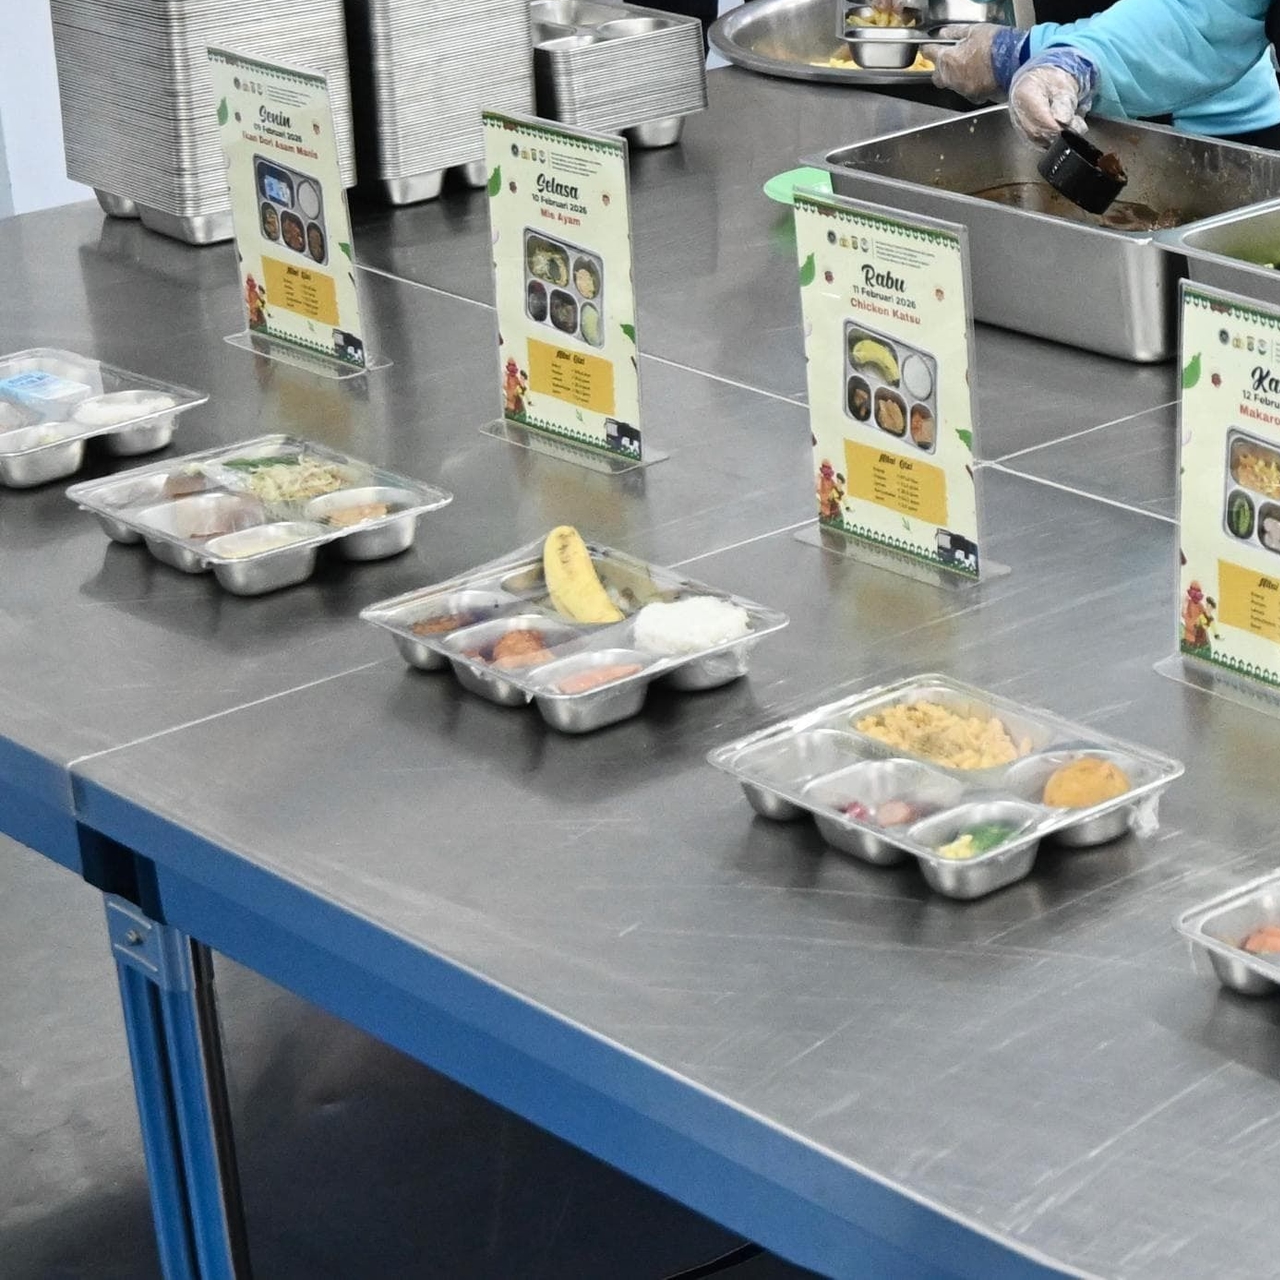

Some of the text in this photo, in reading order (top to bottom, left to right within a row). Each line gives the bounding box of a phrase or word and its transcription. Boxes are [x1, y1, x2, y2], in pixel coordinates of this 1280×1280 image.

[259, 105, 291, 128] Senin
[536, 173, 579, 200] Selasa
[532, 193, 587, 214] 10 Februari 2026
[541, 208, 581, 226] Mie Ayam
[861, 264, 906, 293] Rabu
[853, 285, 916, 309] 11 Februari 2026
[850, 297, 921, 325] Chicken Katsu
[1242, 390, 1251, 400] 12
